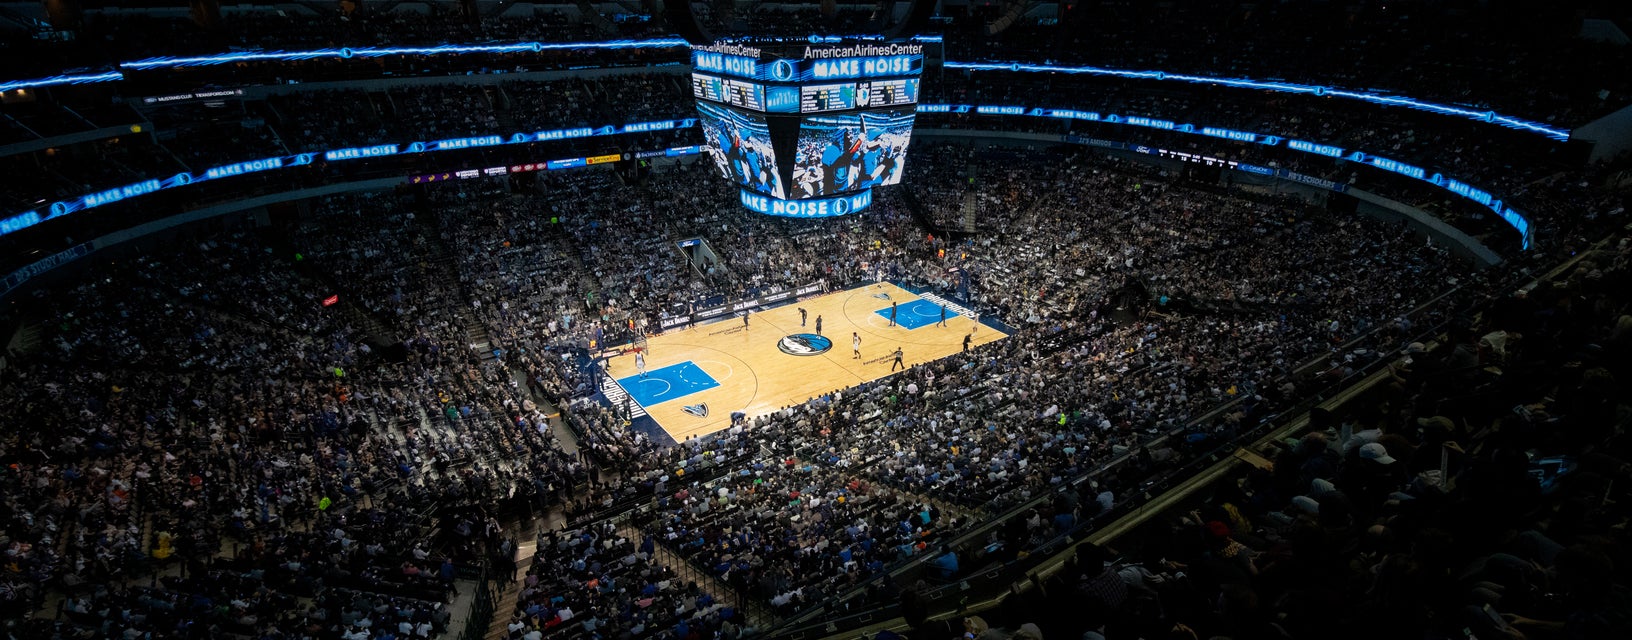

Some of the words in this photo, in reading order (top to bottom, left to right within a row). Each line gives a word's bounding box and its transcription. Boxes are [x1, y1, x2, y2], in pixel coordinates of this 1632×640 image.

[804, 43, 923, 59] AmericanAirlinesCenter
[697, 55, 722, 70] MAKE
[726, 58, 756, 75] NOISE
[814, 60, 859, 77] MAKE
[866, 58, 910, 74] NOISE
[978, 106, 1000, 114] MAKE
[1002, 107, 1024, 115] NOISE
[1053, 110, 1075, 119] MAKE
[1077, 112, 1099, 121] NOISE
[625, 123, 648, 131] MAKE
[650, 121, 674, 129] NOISE
[1128, 117, 1149, 126] MAKE
[1152, 120, 1174, 130] NOISE
[537, 130, 564, 140] MAKE
[566, 128, 593, 137] NOISE
[1203, 128, 1227, 138] MAKE
[1229, 131, 1255, 142] NOISE
[439, 139, 469, 149] MAKE
[471, 136, 501, 146] NOISE
[1136, 145, 1150, 154] Ford
[1289, 140, 1313, 151] MAKE
[1315, 146, 1342, 157] NOISE
[327, 149, 358, 161] MAKE
[363, 145, 397, 157] NOISE
[208, 165, 240, 179] MAKE
[244, 158, 281, 173] NOISE
[1374, 157, 1396, 170] MAKE
[1398, 164, 1424, 179] NOISE
[85, 188, 121, 208] MAKE
[123, 179, 161, 198] NOISE
[773, 200, 828, 216] NOISE
[2, 212, 39, 233] NOISE
